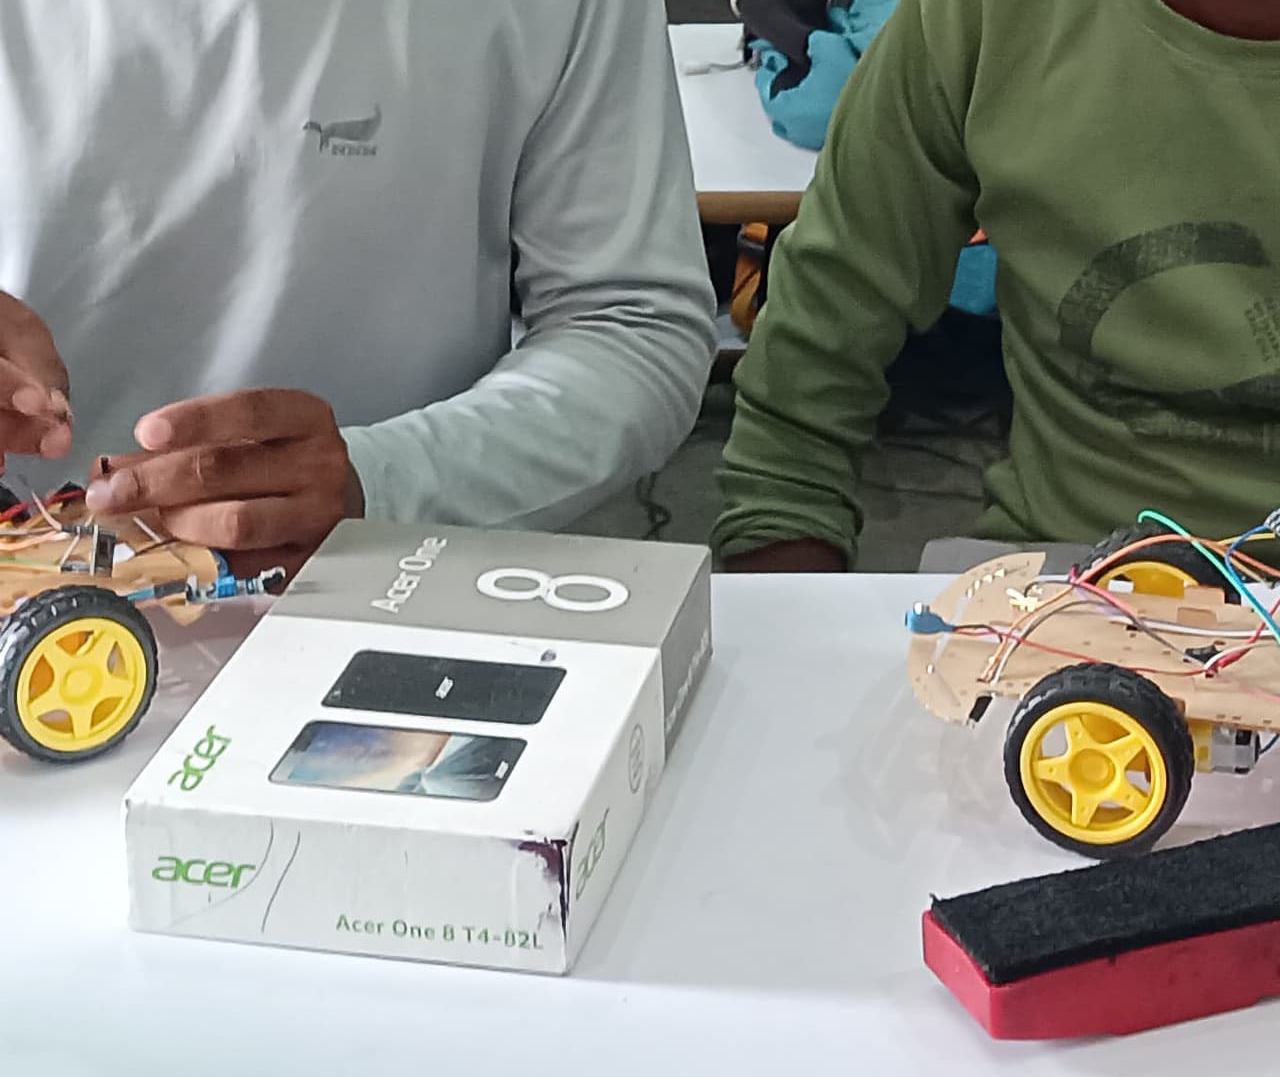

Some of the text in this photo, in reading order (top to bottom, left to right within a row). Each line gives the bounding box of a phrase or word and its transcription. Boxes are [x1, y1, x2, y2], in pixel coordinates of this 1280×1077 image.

[371, 536, 448, 614] Acer One
[476, 567, 629, 612] 8
[167, 724, 232, 791] acer
[151, 855, 257, 889] acer
[335, 914, 385, 936] Acer
[392, 919, 436, 941] One
